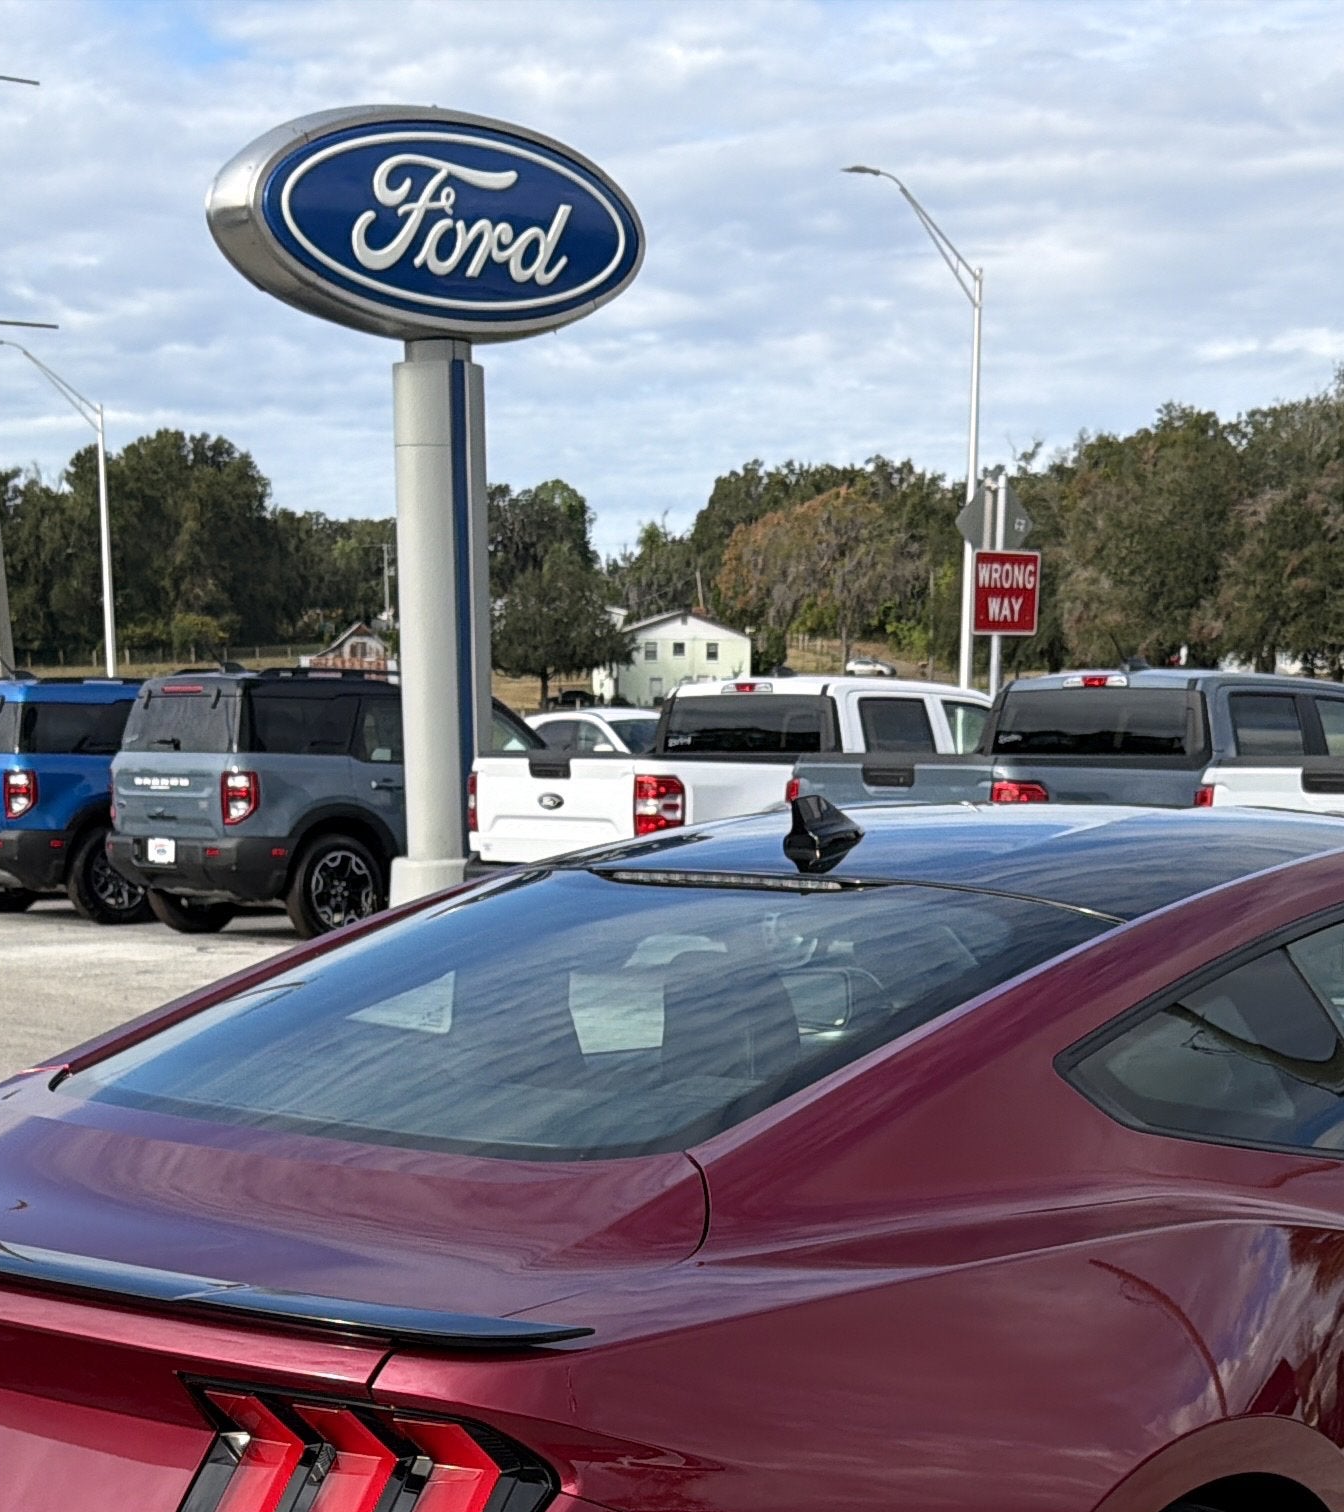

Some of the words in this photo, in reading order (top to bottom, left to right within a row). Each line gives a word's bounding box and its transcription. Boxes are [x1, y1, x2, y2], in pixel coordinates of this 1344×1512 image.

[351, 153, 573, 286] Ford
[977, 562, 1036, 590] WRONG
[987, 595, 1025, 622] WAY
